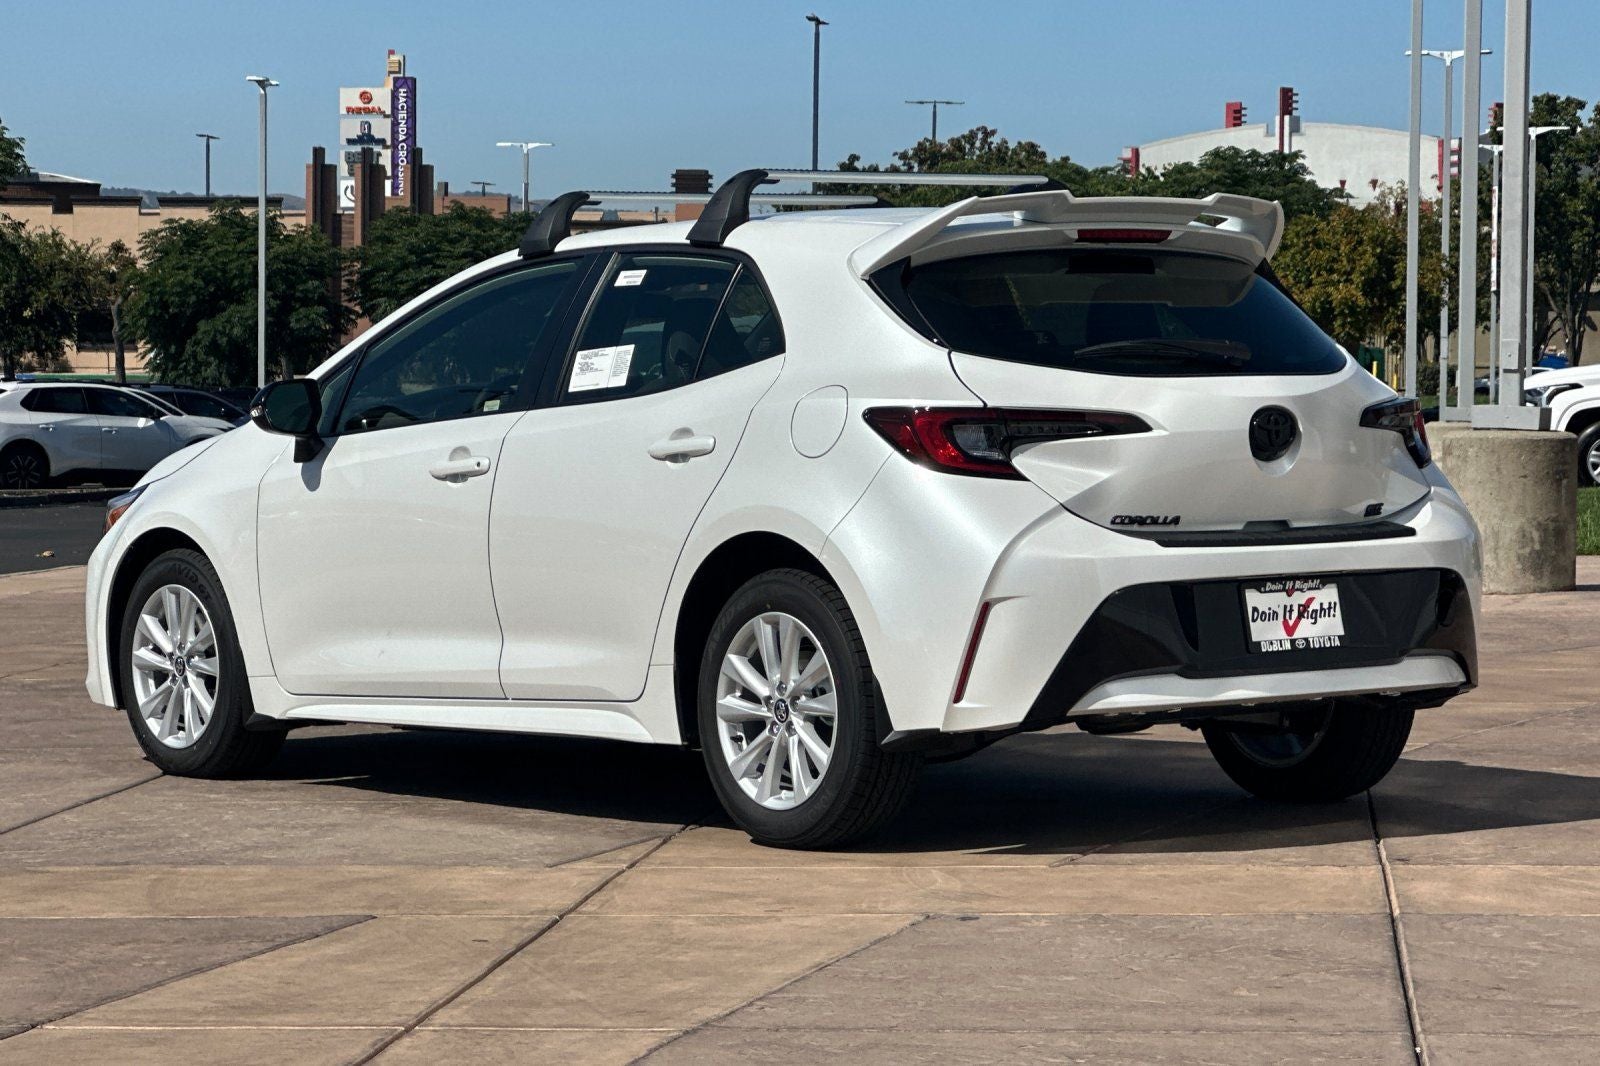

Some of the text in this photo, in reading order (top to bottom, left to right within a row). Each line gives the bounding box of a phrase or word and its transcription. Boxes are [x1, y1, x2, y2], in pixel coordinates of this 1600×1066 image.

[398, 88, 407, 141] HACIENDA
[345, 151, 382, 164] BET
[1110, 514, 1181, 526] COROLLA
[1251, 601, 1338, 625] Doin' It Right!
[1261, 636, 1340, 652] DUBLIN TOYOTA
